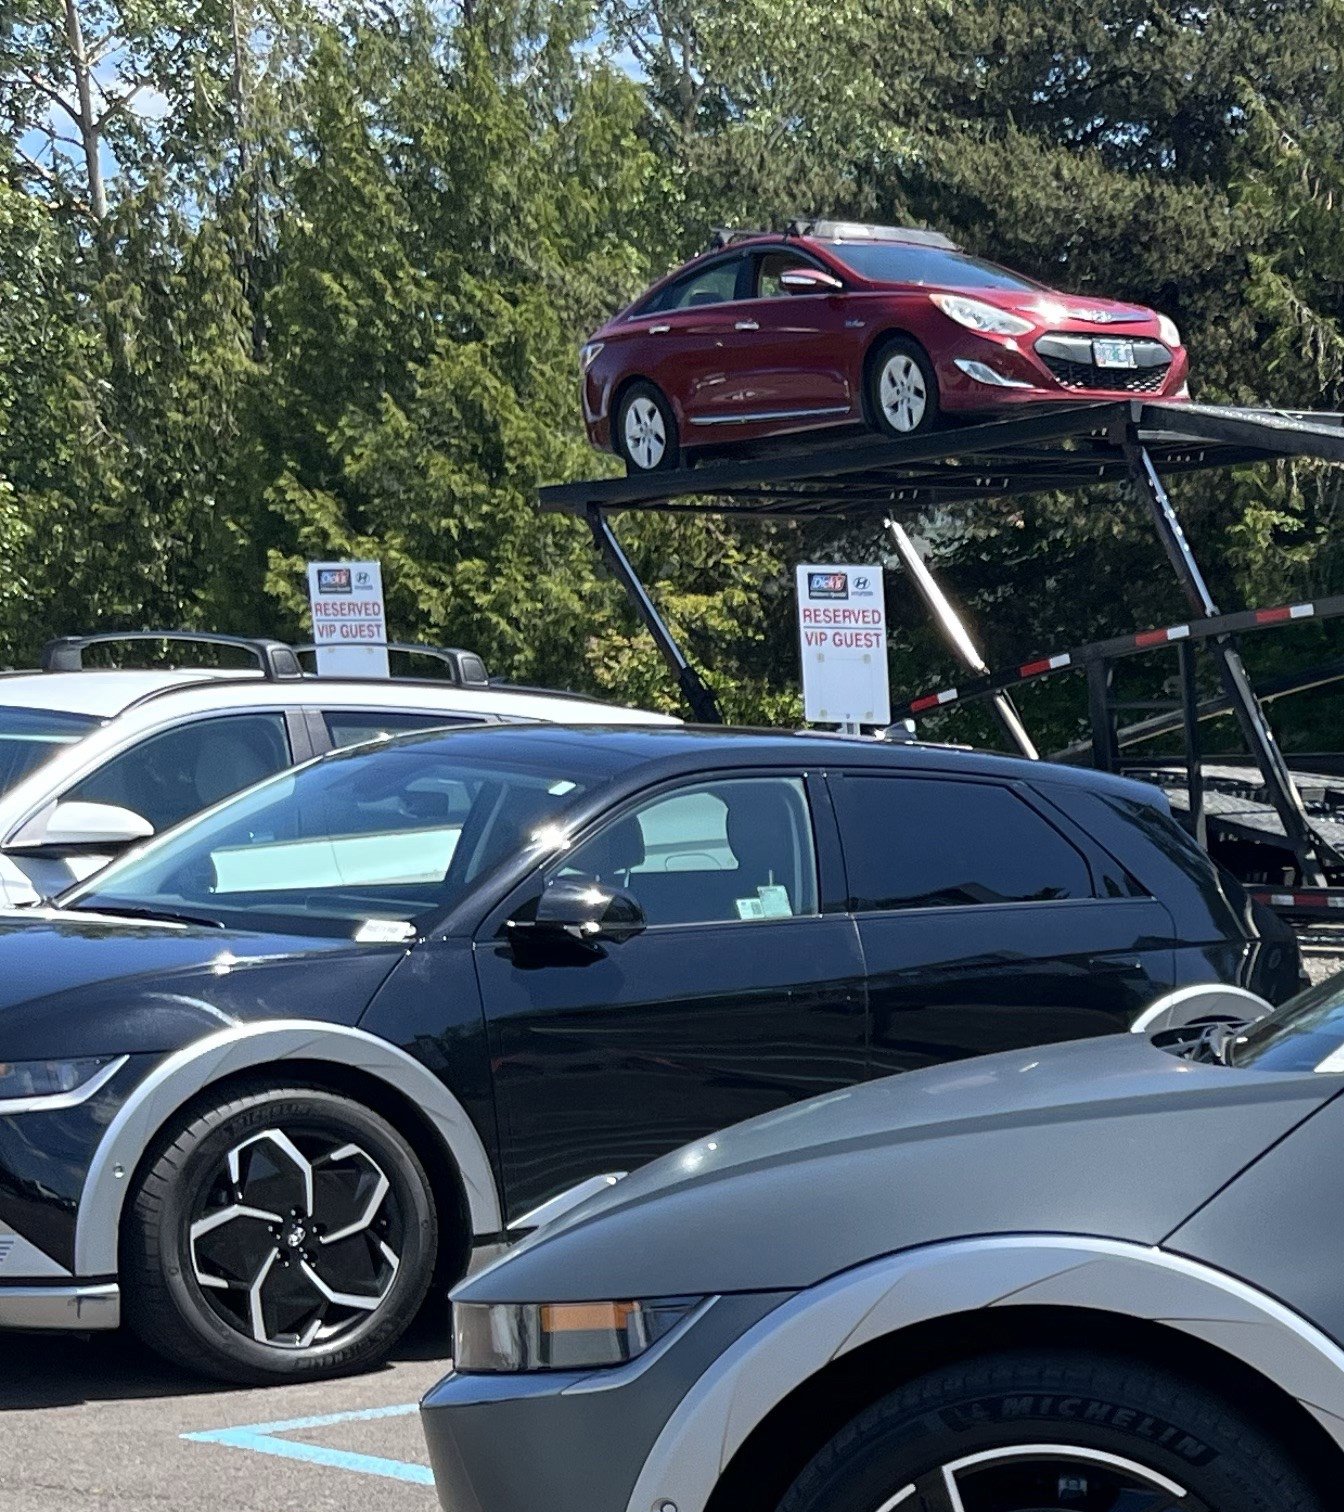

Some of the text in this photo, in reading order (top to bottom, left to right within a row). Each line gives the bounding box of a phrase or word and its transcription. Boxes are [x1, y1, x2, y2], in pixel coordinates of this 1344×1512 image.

[314, 601, 381, 617] RESERVED
[803, 608, 882, 625] RESERVED
[317, 623, 382, 639] VIP GUEST
[805, 631, 882, 649] VIP GUEST
[1002, 1395, 1210, 1461] MICHELIN
